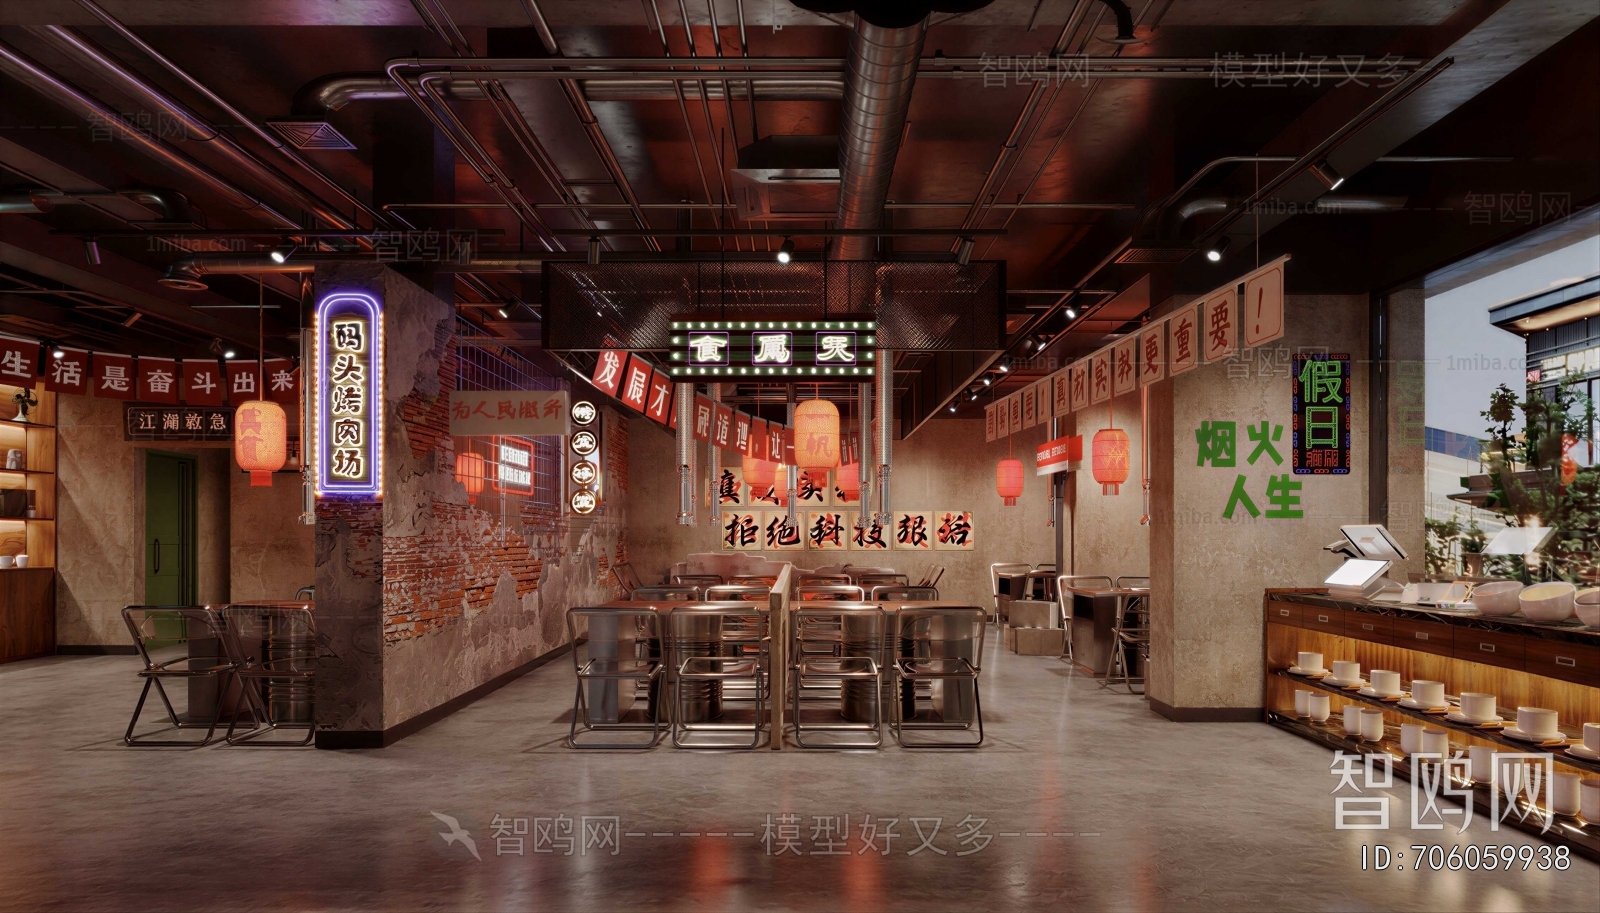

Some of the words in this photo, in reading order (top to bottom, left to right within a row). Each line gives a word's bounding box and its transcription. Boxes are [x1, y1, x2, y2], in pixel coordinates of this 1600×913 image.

[1298, 359, 1344, 449] 假日
[1195, 420, 1284, 467] 烟火
[1223, 474, 1303, 519] 人生
